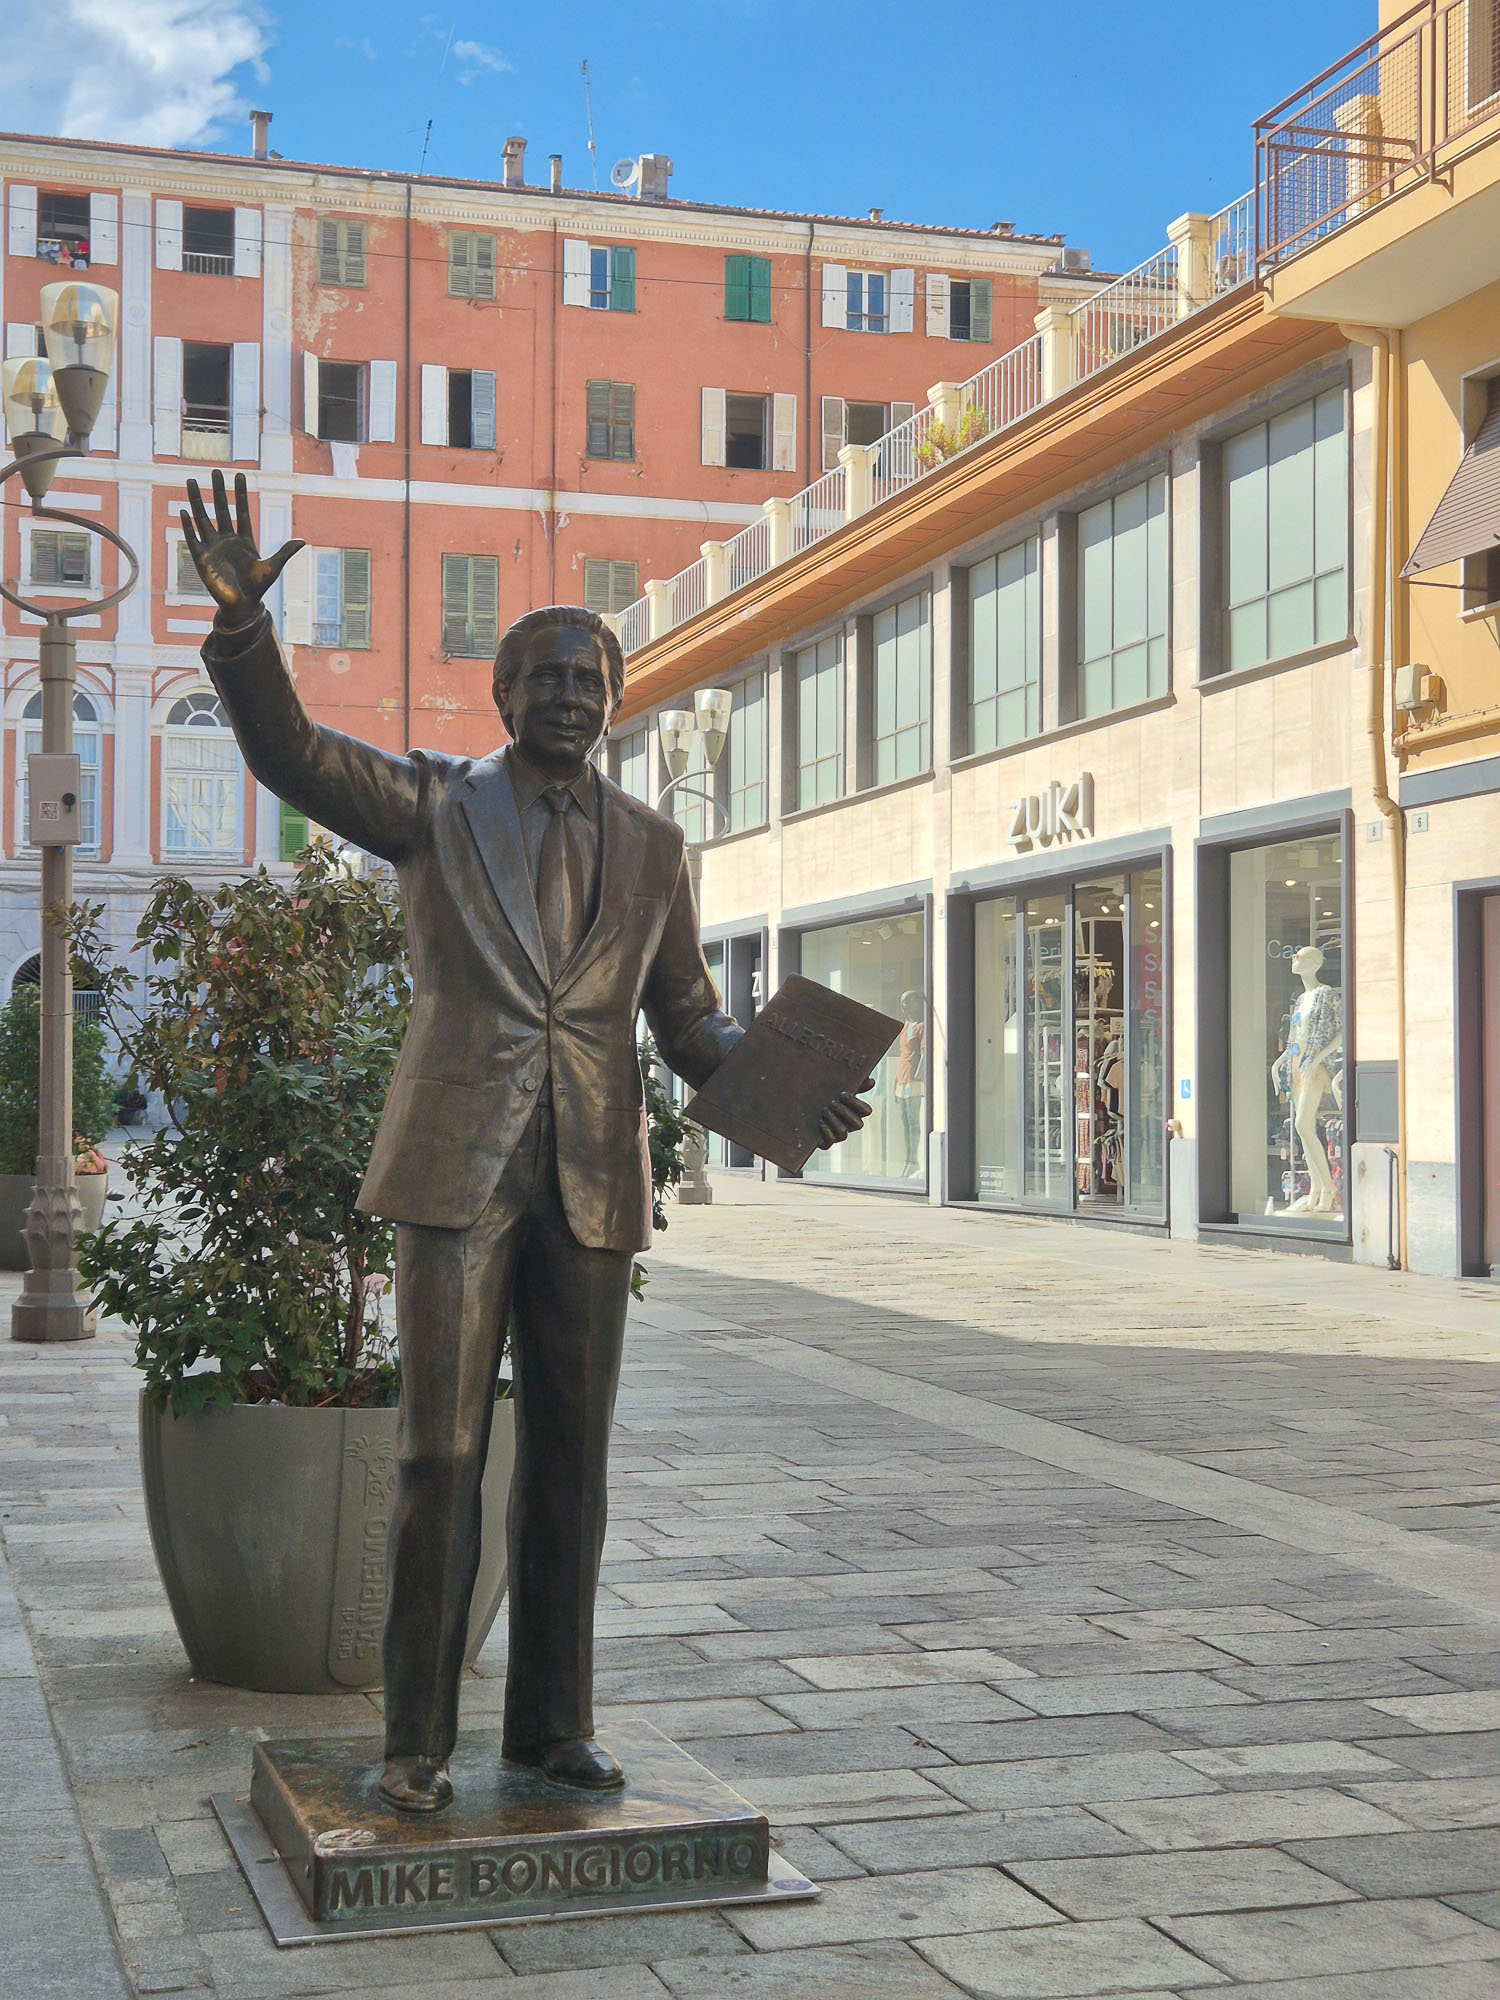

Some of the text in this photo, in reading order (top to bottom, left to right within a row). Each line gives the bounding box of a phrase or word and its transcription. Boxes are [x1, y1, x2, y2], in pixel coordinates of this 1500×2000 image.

[1004, 771, 1094, 852] ZUIKI
[355, 1520, 386, 1659] SANREMO
[329, 1837, 758, 1910] MIKE BONGIORNO
